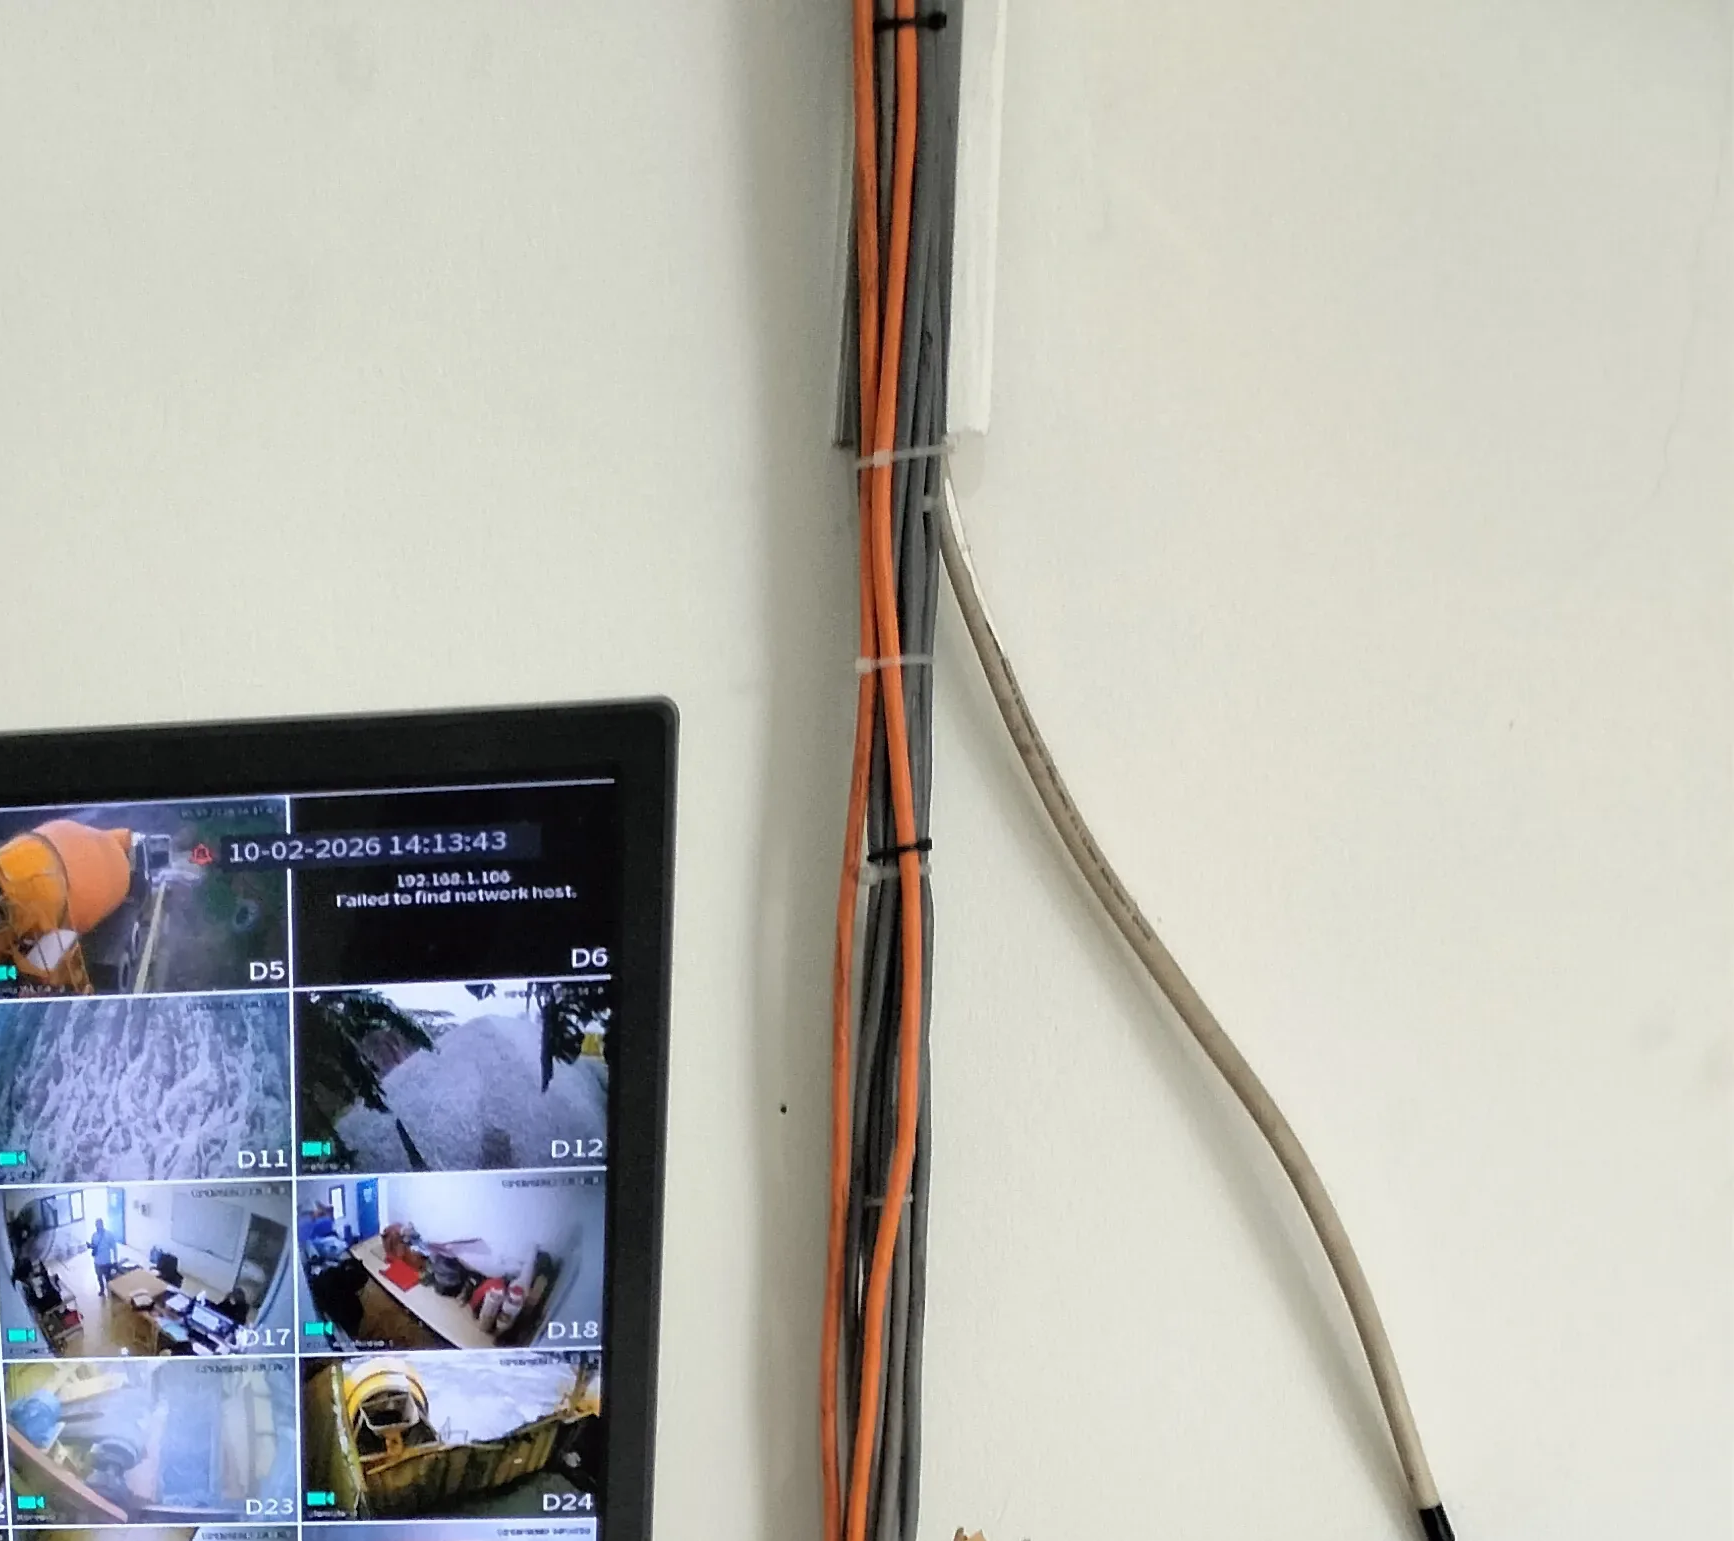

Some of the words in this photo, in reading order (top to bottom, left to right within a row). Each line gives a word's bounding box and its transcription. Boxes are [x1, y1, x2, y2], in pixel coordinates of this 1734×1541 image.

[230, 837, 381, 863] 10-02-2026
[389, 831, 507, 855] 14:13:43
[572, 948, 607, 967] D6
[250, 961, 284, 980] D5
[552, 1139, 602, 1157] D12
[238, 1150, 287, 1168] D11
[548, 1322, 597, 1339] D18
[247, 1499, 293, 1514] D23
[543, 1494, 592, 1510] D24
